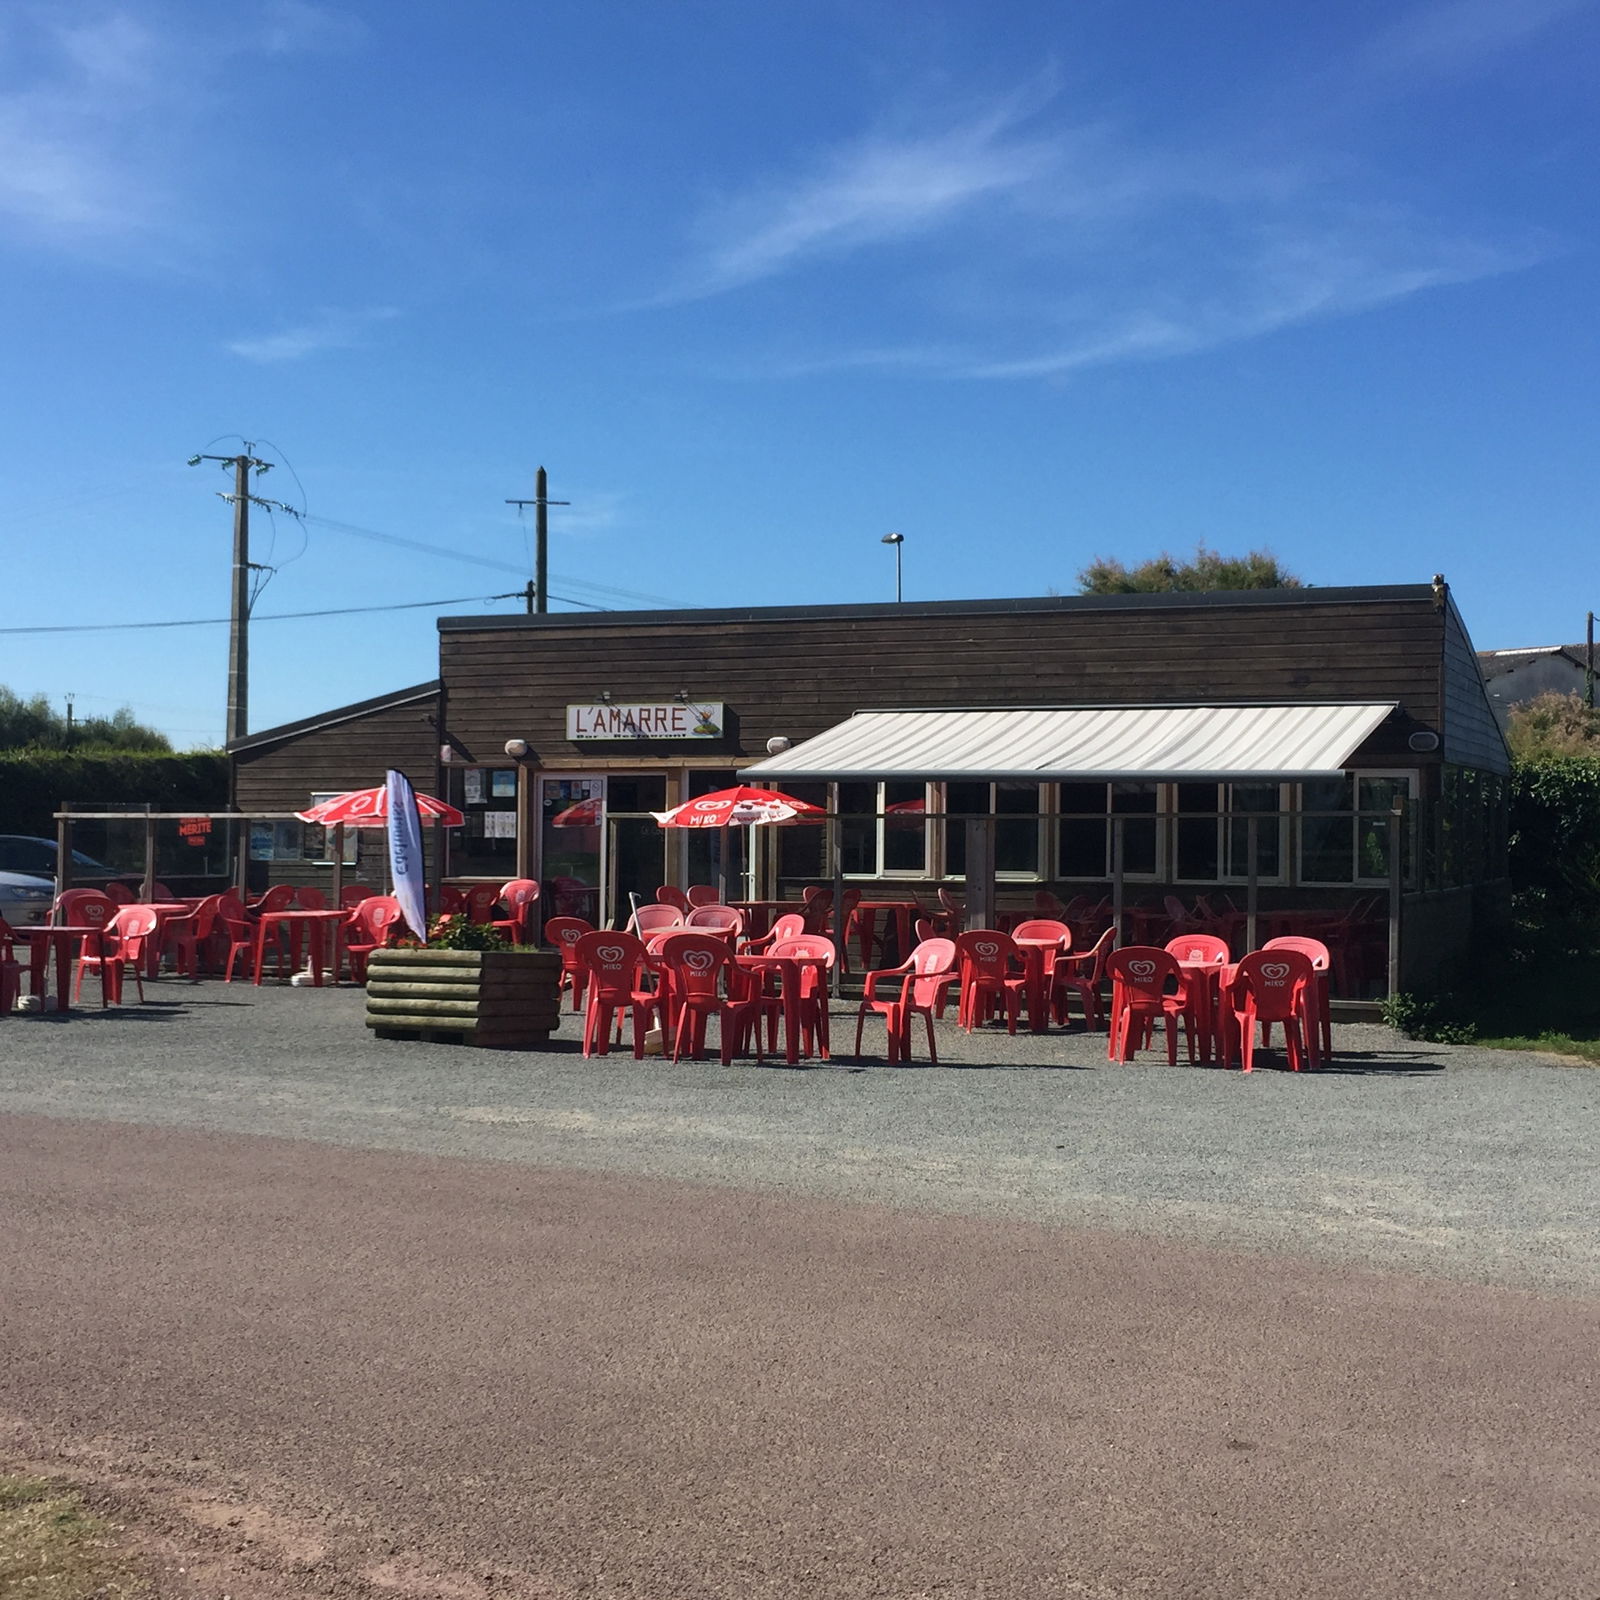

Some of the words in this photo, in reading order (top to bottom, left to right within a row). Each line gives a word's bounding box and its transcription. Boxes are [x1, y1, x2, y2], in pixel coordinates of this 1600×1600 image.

[576, 707, 687, 733] L'AMARRE
[690, 814, 718, 825] MIKO
[602, 963, 622, 971] MIKO
[1264, 980, 1285, 988] MIKO
